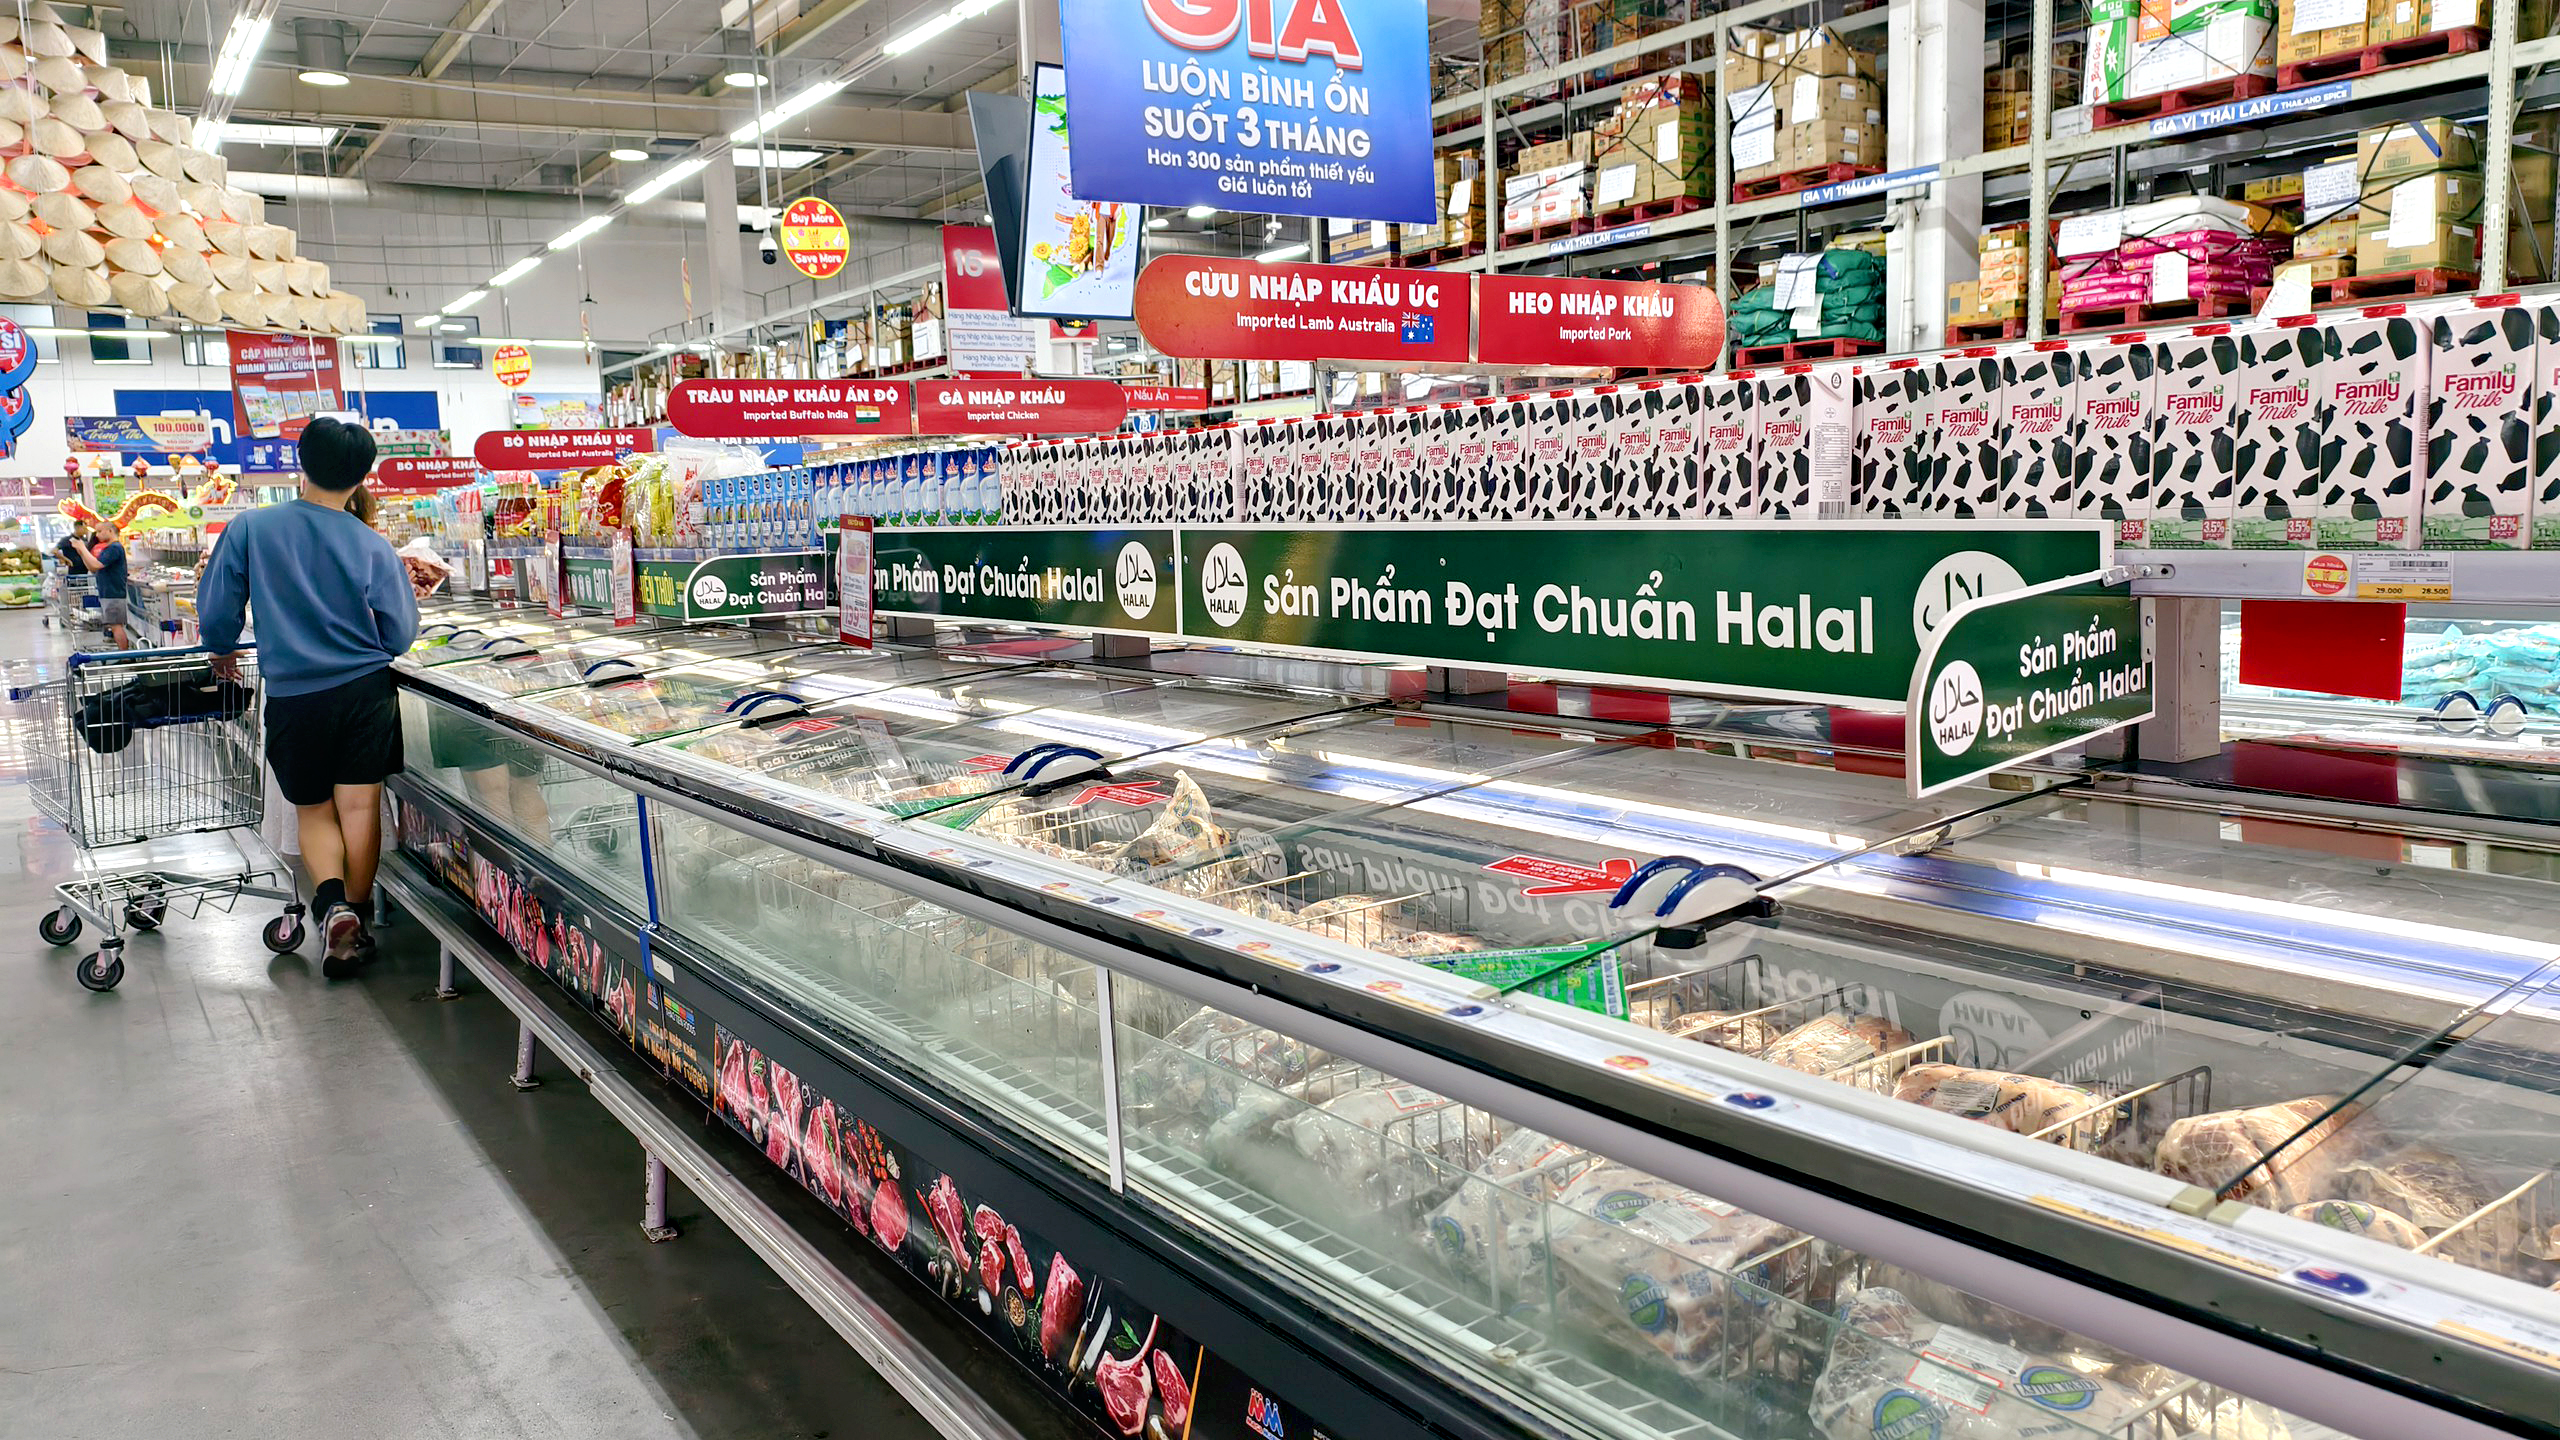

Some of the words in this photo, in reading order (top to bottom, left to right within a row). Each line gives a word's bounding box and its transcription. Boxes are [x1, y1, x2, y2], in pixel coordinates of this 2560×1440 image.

[1142, 58, 1230, 98] LUÔN
[1242, 65, 1314, 108] BÌNH
[1325, 69, 1369, 115] ỔN
[2153, 122, 2176, 134] GIA
[2182, 119, 2196, 130] VỊ
[2201, 106, 2235, 124] THÁI
[2240, 101, 2270, 118] LAN
[2281, 96, 2321, 109] THAILAND
[2324, 90, 2347, 100] SPICE
[1144, 100, 1229, 143] SUỐT
[1236, 107, 1260, 147] 3
[1264, 121, 1371, 158] THÁNG
[1147, 148, 1182, 167] Hơn
[1187, 150, 1221, 172] 300
[1225, 156, 1255, 174] sản
[1259, 158, 1306, 179] phẩm
[1309, 163, 1344, 181] thiết
[1347, 167, 1374, 185] yếu
[1218, 175, 1248, 194] Giá
[1252, 179, 1287, 196] luôn
[1290, 180, 1313, 199] tốt
[1803, 192, 1820, 202] GIA
[1823, 187, 1833, 200] VỊ
[791, 214, 807, 225] Buy
[812, 212, 834, 224] More
[1551, 243, 1563, 253] GIA
[1594, 232, 1611, 244] LAN
[795, 252, 817, 264] Save
[819, 252, 842, 264] More
[953, 248, 983, 276] 16
[1184, 265, 1239, 298] CỪU
[1249, 274, 1319, 307] NHẬP
[1331, 273, 1401, 305] KHẨU
[1408, 276, 1439, 307] ÚC
[1509, 292, 1553, 314] HEO
[1559, 291, 1618, 321] NHẬP
[1624, 289, 1674, 317] KHẨU
[1236, 311, 1296, 333] Imported
[1299, 315, 1335, 332] Lamb
[1338, 315, 1395, 333] Australia
[1559, 327, 1605, 341] Imported
[1608, 327, 1632, 340] Pork
[236, 363, 265, 374] NHANH
[318, 359, 332, 368] MM
[2335, 379, 2400, 400] Family
[2445, 370, 2516, 393] Family
[687, 387, 737, 404] TRÂU
[739, 388, 789, 408] NHẬP
[794, 386, 841, 404] KHẨU
[845, 386, 871, 403] ẤN
[873, 386, 898, 407] ĐỘ
[939, 389, 964, 404] GÀ
[968, 390, 1017, 408] NHẬP
[1020, 389, 1065, 404] KHẨU
[2167, 391, 2223, 412] Family
[2250, 385, 2308, 406] Family
[2454, 390, 2502, 409] Milk
[743, 409, 786, 422] Imported
[789, 409, 824, 420] Buffalo
[827, 409, 848, 420] India
[2012, 402, 2062, 421] Family
[2086, 397, 2140, 416] Family
[2258, 402, 2298, 420] Milk
[2345, 397, 2389, 416] Milk
[967, 411, 1004, 422] Imported
[1006, 411, 1040, 420] Chicken
[1871, 417, 1912, 435] Family
[1942, 406, 1989, 427] Family
[2019, 417, 2053, 433] Milk
[2094, 413, 2131, 429] Milk
[2176, 408, 2214, 425] Milk
[1877, 430, 1905, 444] Milk
[1948, 421, 1981, 436] Milk
[503, 434, 524, 448] BÒ
[528, 435, 568, 449] NHẬP
[572, 432, 612, 446] KHẨU
[617, 433, 634, 445] ÚC
[528, 451, 560, 459] Imported
[562, 450, 580, 458] Beef
[396, 461, 413, 471] BÒ
[415, 461, 449, 472] NHẬP
[2203, 520, 2225, 533] 3.5%
[2288, 519, 2310, 532] 3.5%
[2377, 519, 2402, 533] 3.5%
[2490, 517, 2518, 532] 3.5%
[749, 568, 777, 586] Sản
[779, 566, 817, 585] Phẩm
[1122, 546, 1153, 588] حلال
[1205, 554, 1244, 594] حلال
[695, 579, 725, 597] حلال
[892, 555, 939, 593] Phẩm
[944, 561, 976, 603] Đạt
[981, 555, 1041, 597] Chuẩn
[1048, 567, 1104, 602] Halal
[729, 588, 754, 607] Đạt
[756, 581, 801, 603] Chuẩn
[1123, 591, 1150, 608] HALAL
[1209, 598, 1240, 615] HALAL
[1263, 568, 1319, 618] Sản
[1331, 564, 1433, 625] Phẩm
[1446, 581, 1520, 642] Đạt
[1534, 569, 1696, 642] Chuẩn
[1717, 591, 1874, 654] Halal
[2020, 636, 2056, 678] Sản
[2063, 614, 2116, 665] Phẩm
[1934, 674, 1979, 724] حلال
[1986, 696, 2023, 741] Đạt
[2029, 668, 2093, 724] Chuẩn
[2100, 663, 2146, 703] Halal
[1939, 721, 1974, 745] HALAL
